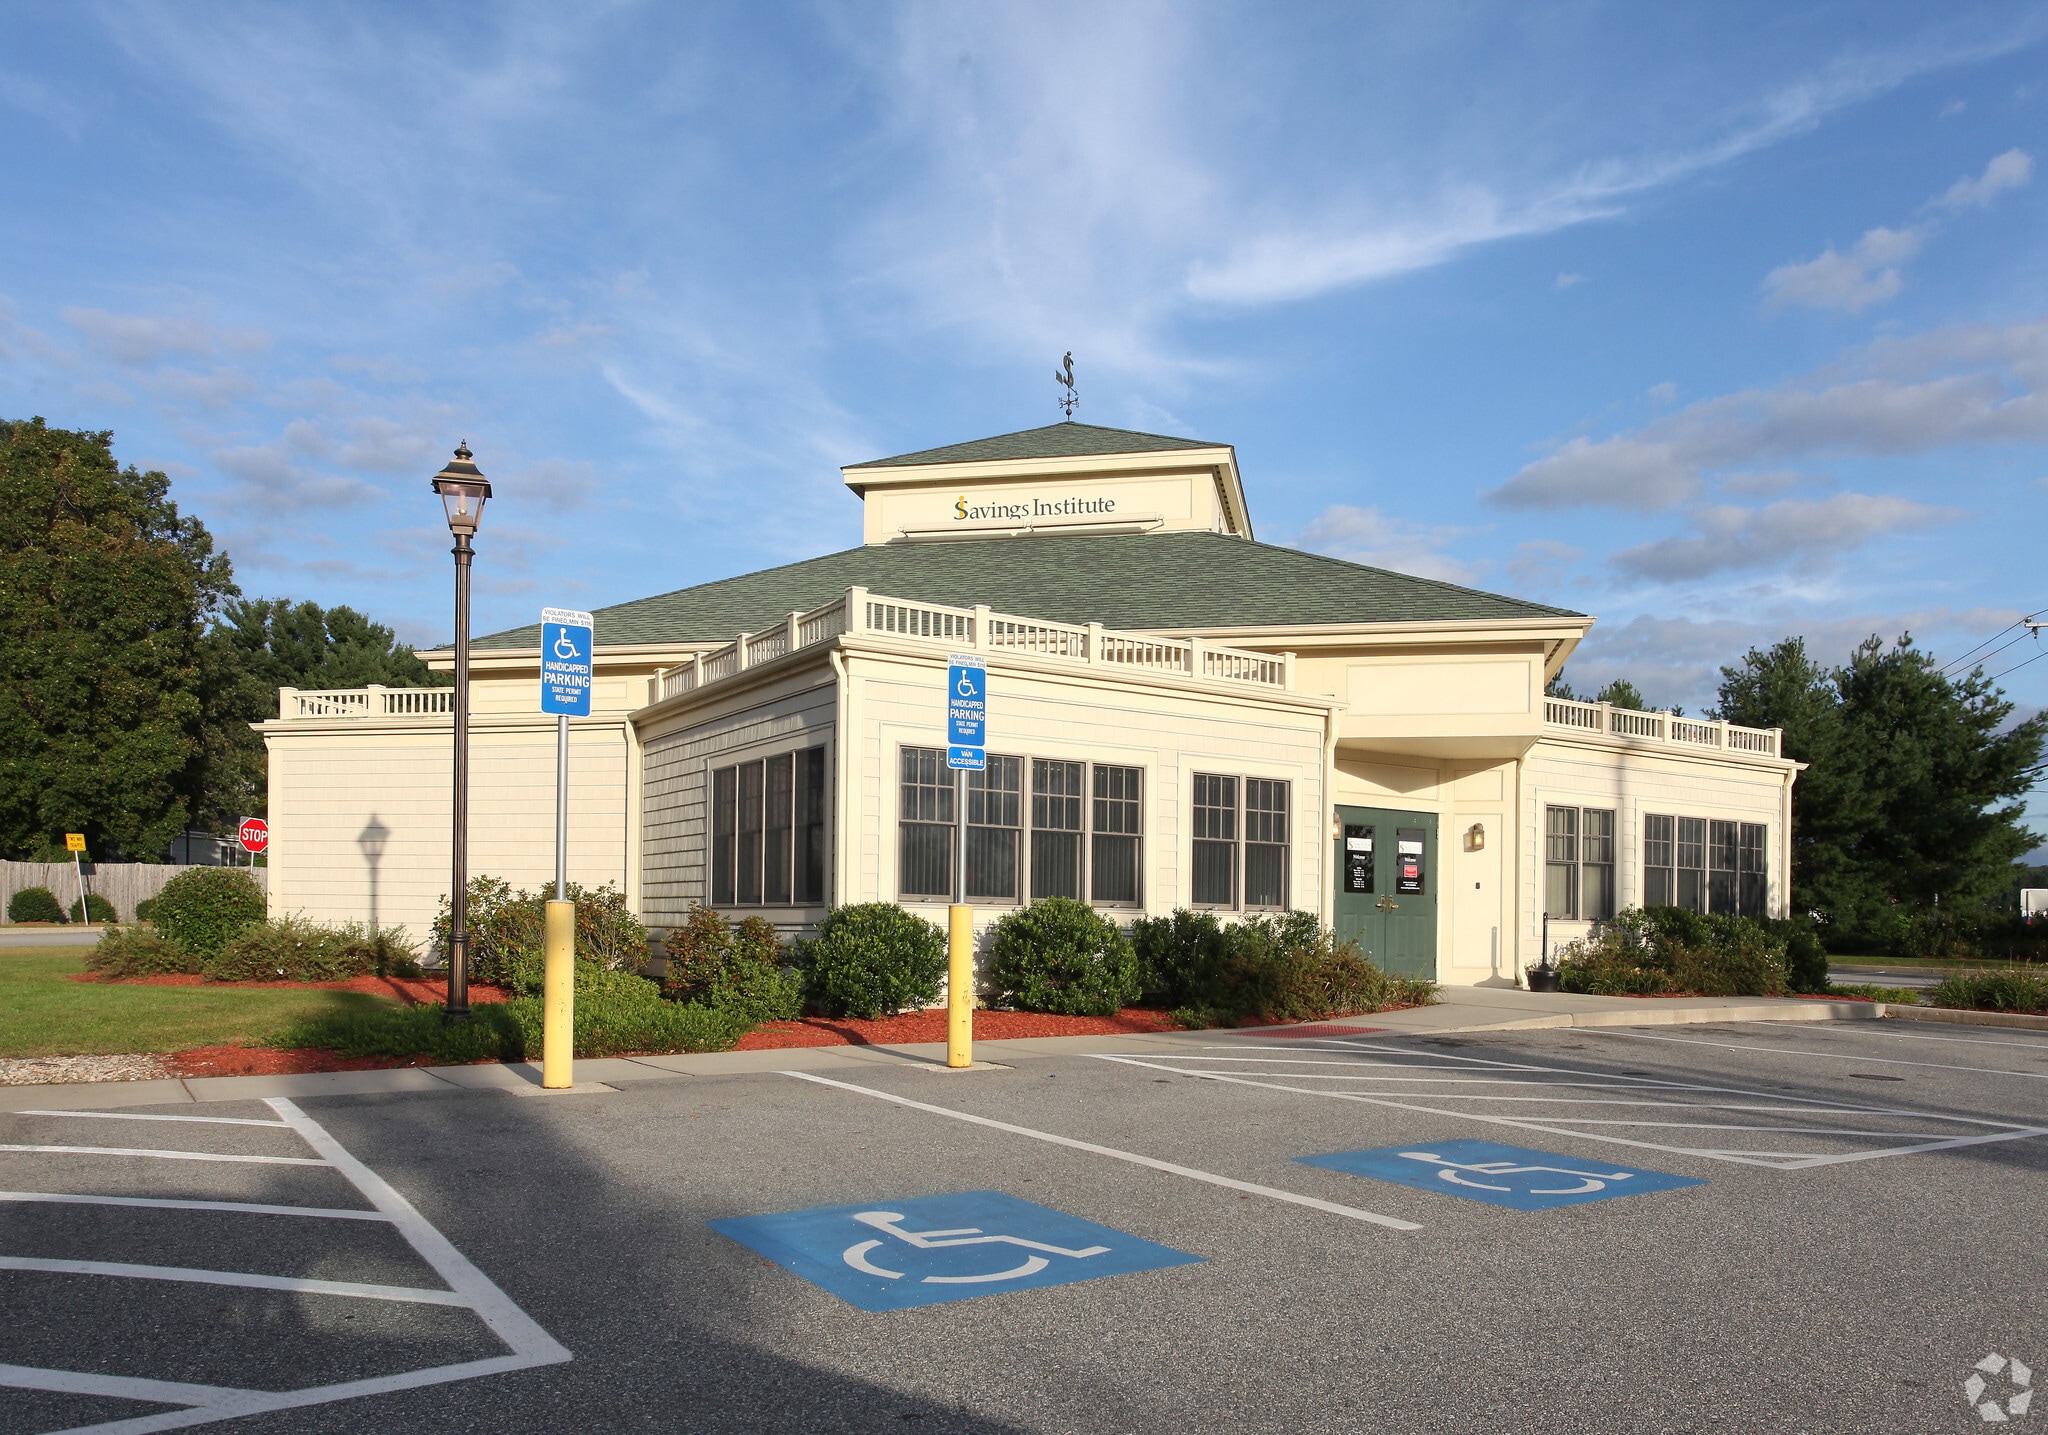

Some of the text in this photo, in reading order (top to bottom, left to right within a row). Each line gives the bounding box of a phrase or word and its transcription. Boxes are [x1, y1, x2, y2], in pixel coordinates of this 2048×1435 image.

[954, 495, 1116, 520] Savings Institute
[544, 610, 576, 618] VIOLATORS
[545, 661, 589, 674] HANDICAPPED
[544, 672, 590, 688] PARKING
[555, 694, 578, 703] REQUIRED
[950, 699, 984, 710] HANDICAPPED
[950, 708, 985, 721] PARKING
[949, 758, 984, 766] ACCESSIBLE
[242, 828, 268, 842] STOP
